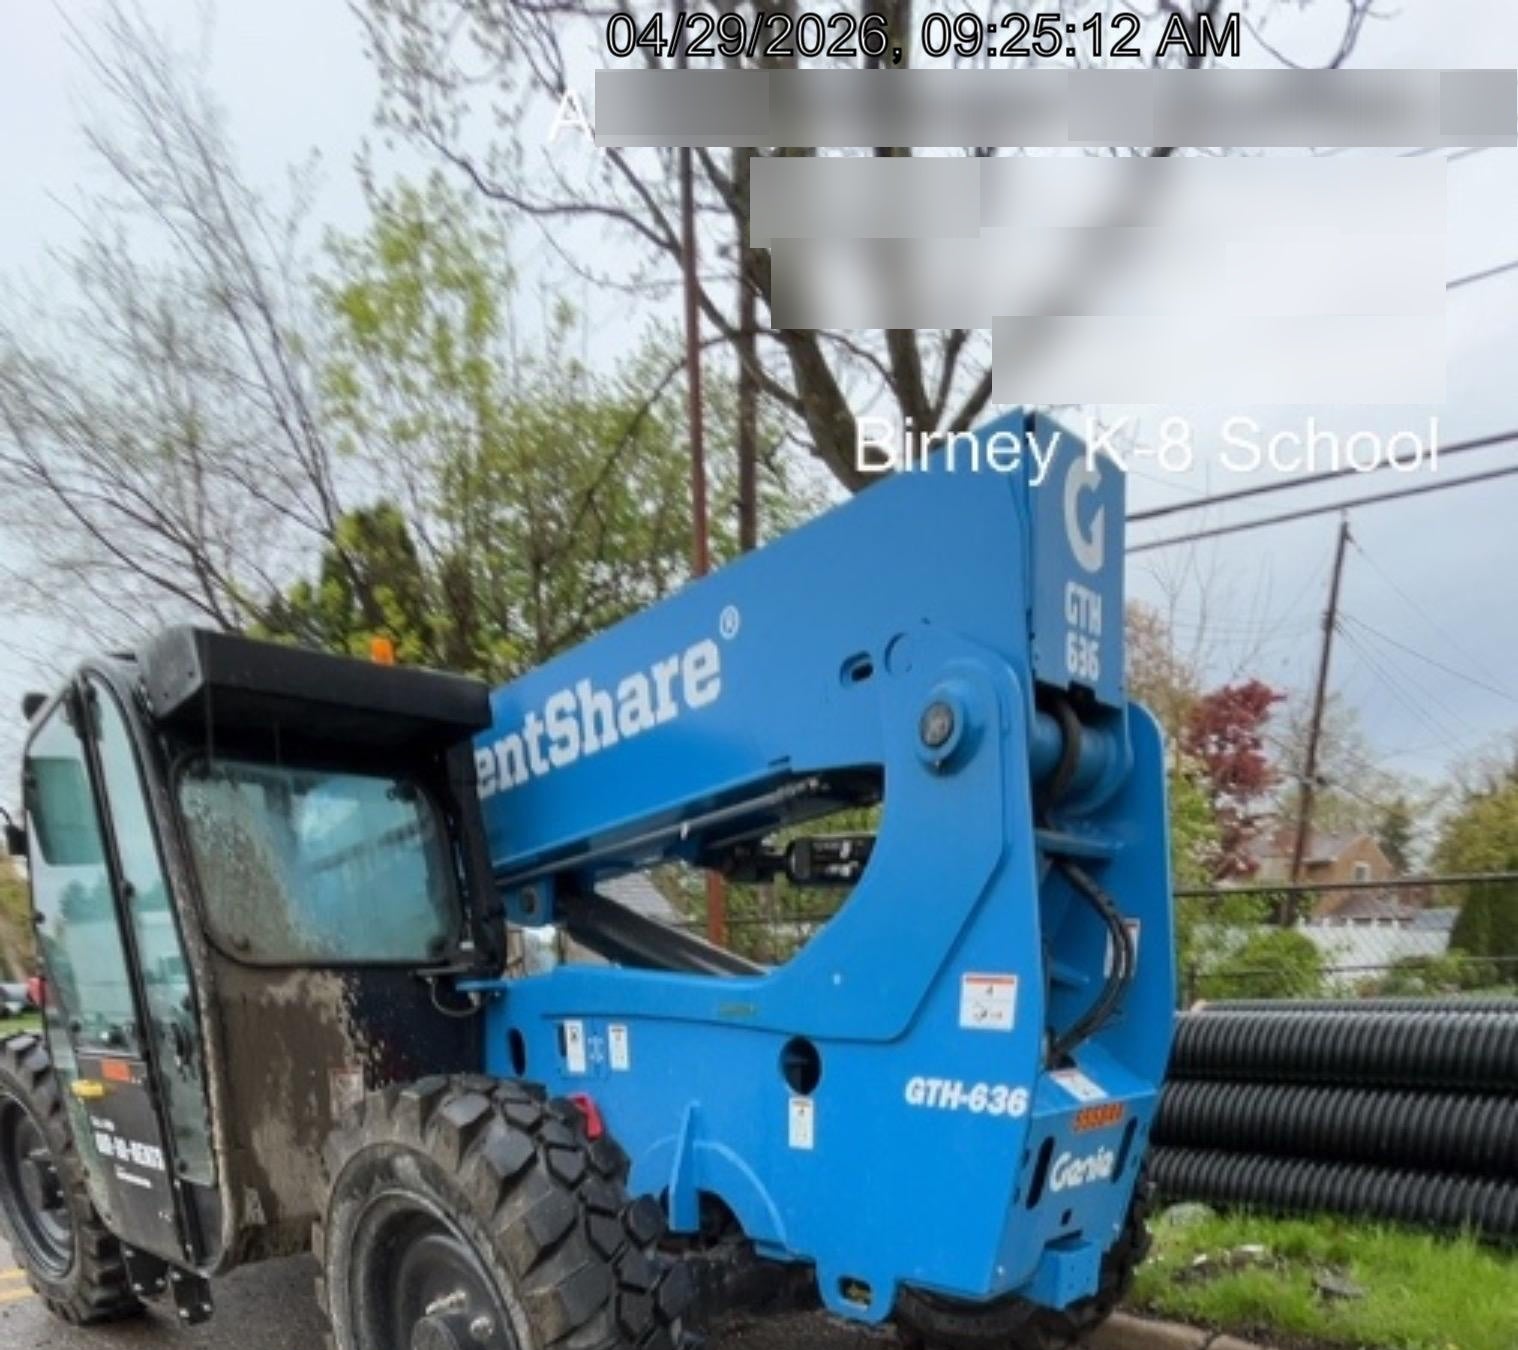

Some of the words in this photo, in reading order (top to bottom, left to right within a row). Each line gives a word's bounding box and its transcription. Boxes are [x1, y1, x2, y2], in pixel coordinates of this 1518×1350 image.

[1064, 581, 1102, 637] GTH
[904, 1076, 1028, 1117] GTH-636
[1051, 1144, 1114, 1192] Genie
